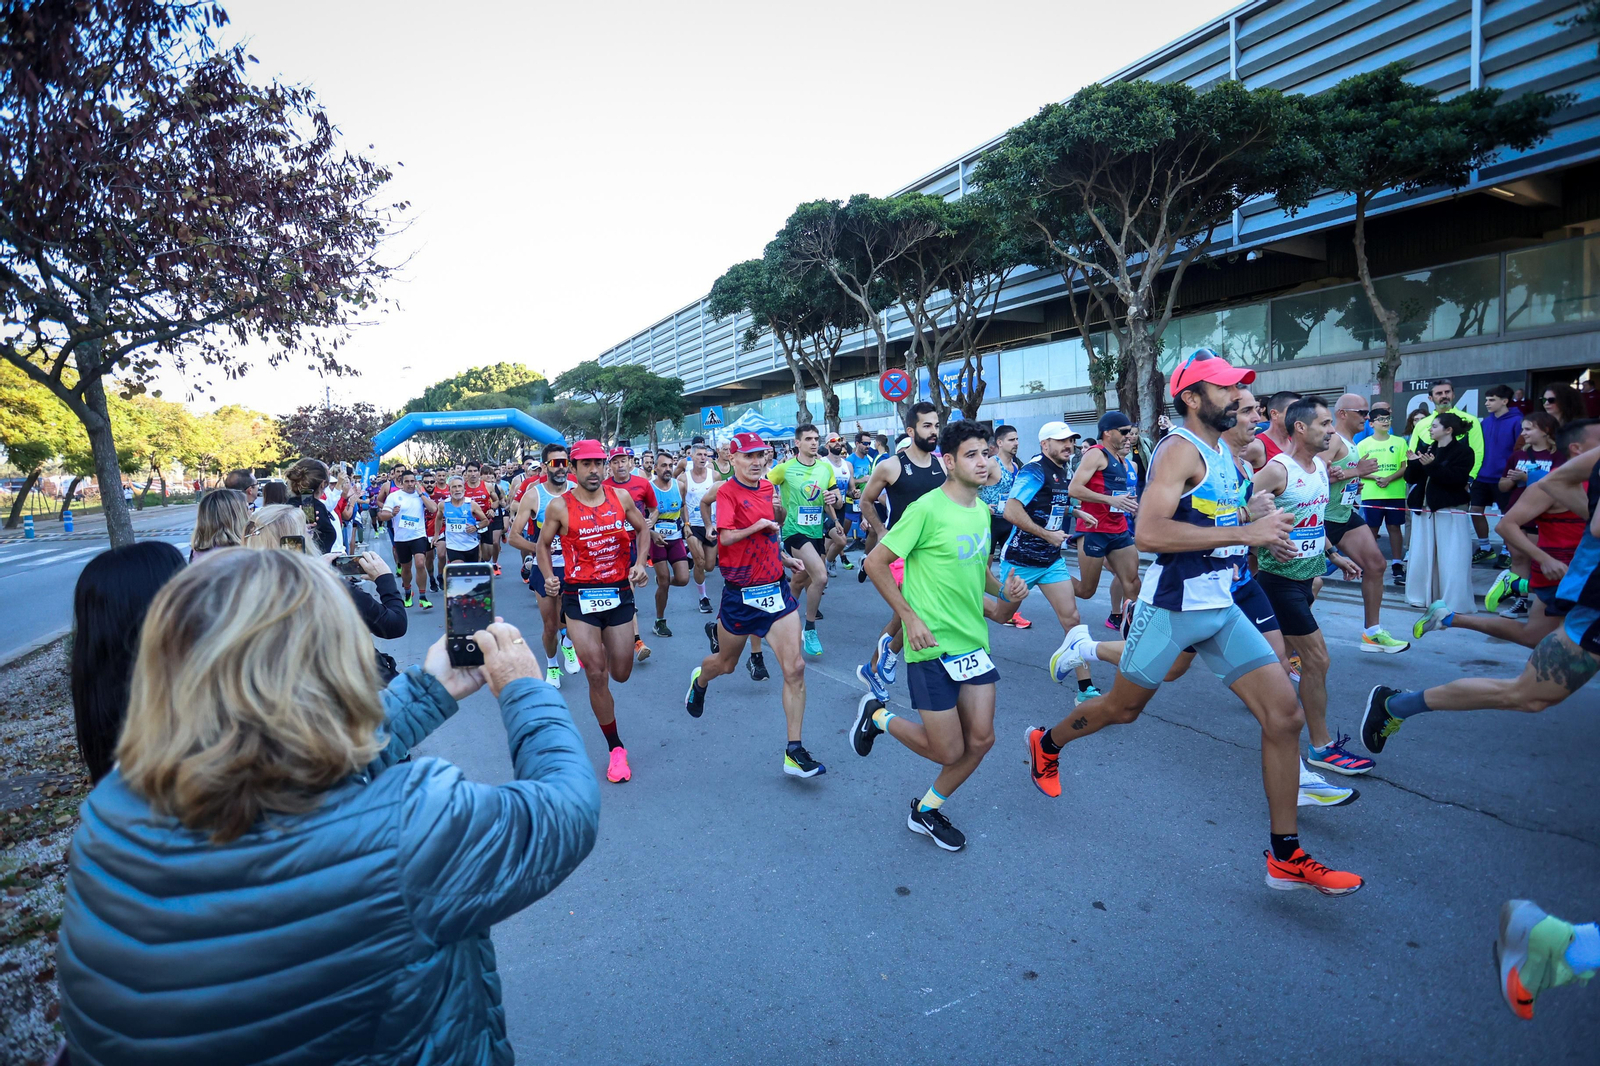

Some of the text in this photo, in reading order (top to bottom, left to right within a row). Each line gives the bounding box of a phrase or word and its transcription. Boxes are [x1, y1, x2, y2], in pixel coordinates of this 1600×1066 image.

[805, 514, 818, 522] 156
[579, 524, 615, 535] Movijerez
[1301, 540, 1316, 552] 64
[590, 599, 612, 607] 306
[954, 654, 979, 673] 725
